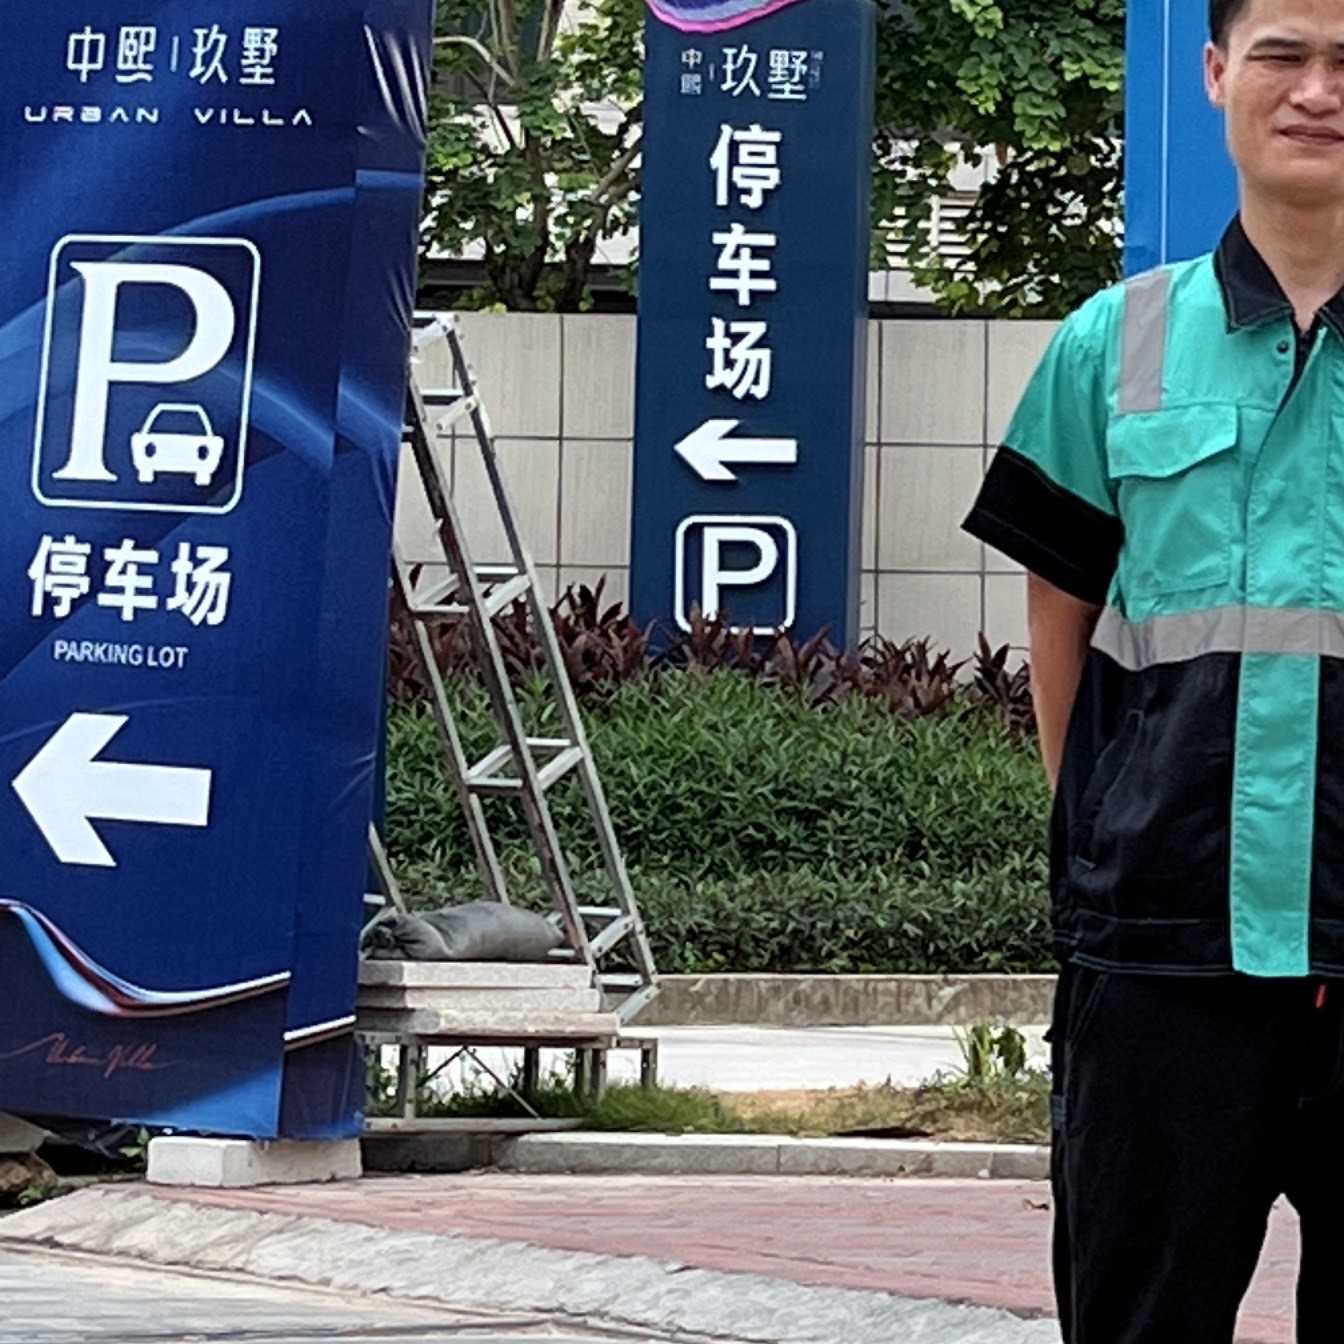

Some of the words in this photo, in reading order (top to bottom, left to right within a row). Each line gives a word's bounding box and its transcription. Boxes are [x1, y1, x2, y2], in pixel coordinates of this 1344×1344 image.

[24, 104, 160, 125] URBAN
[193, 106, 313, 127] VILLA
[720, 43, 808, 101] 玖墅
[705, 123, 783, 400] 停车场
[51, 260, 236, 483] P
[26, 533, 233, 626] 停车场
[701, 526, 780, 623] P
[53, 639, 144, 666] PARKING
[147, 643, 189, 669] LOT
